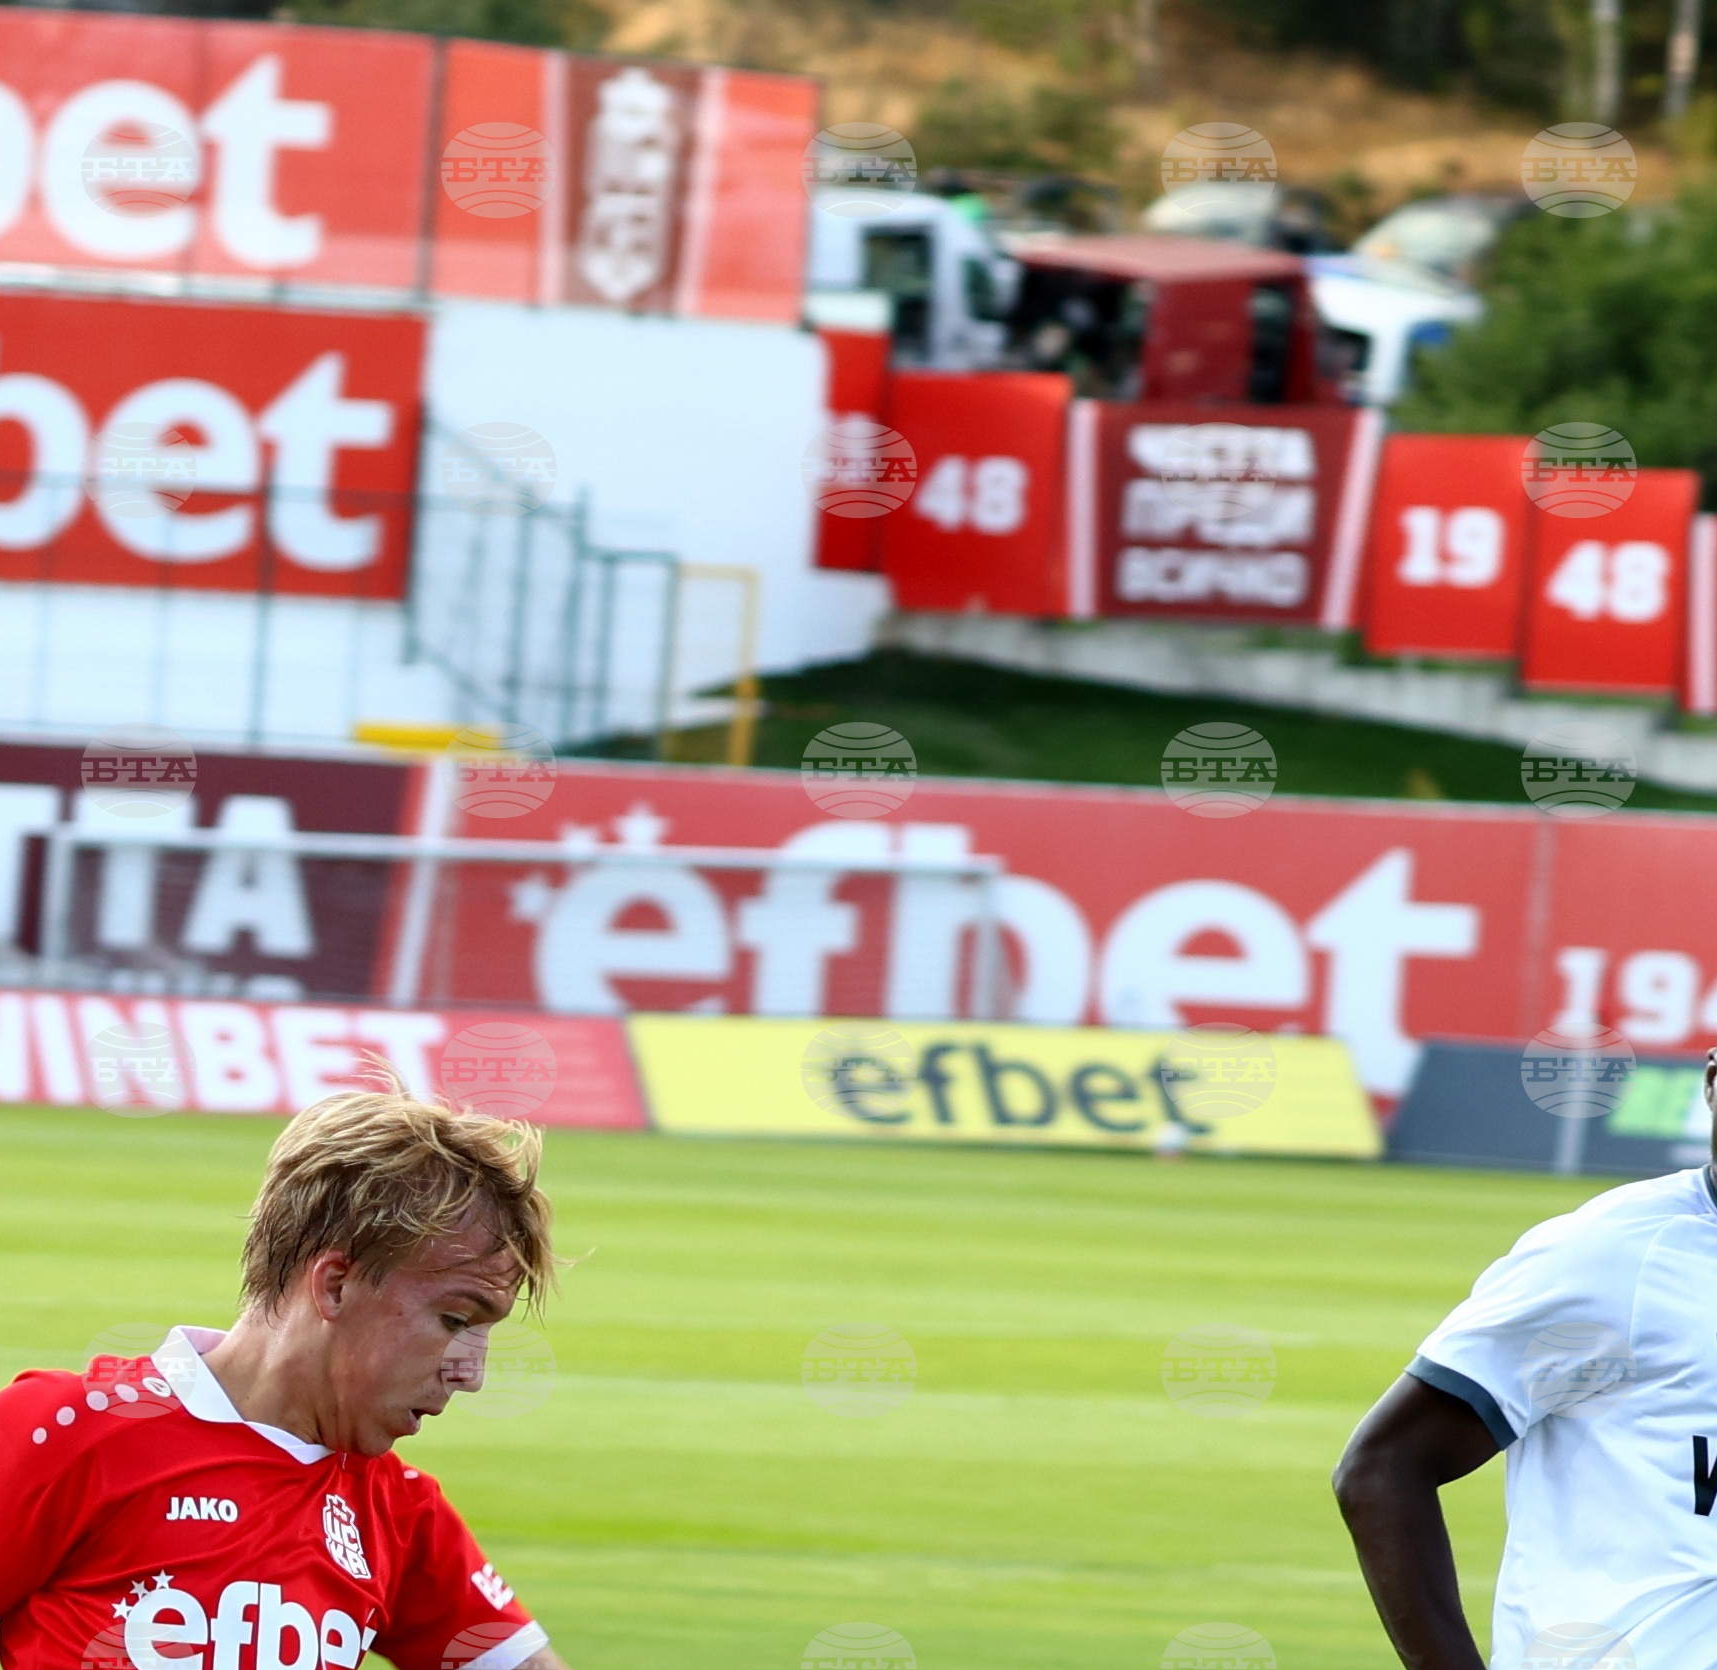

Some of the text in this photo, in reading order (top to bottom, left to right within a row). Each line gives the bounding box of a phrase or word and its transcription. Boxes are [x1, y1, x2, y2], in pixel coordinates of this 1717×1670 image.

[915, 455, 1030, 536] 48
[1396, 503, 1506, 589] 19
[1544, 538, 1673, 625] 48
[534, 820, 1479, 1099] efbet
[827, 1042, 1215, 1137] efbet
[165, 1496, 239, 1524] JAKO
